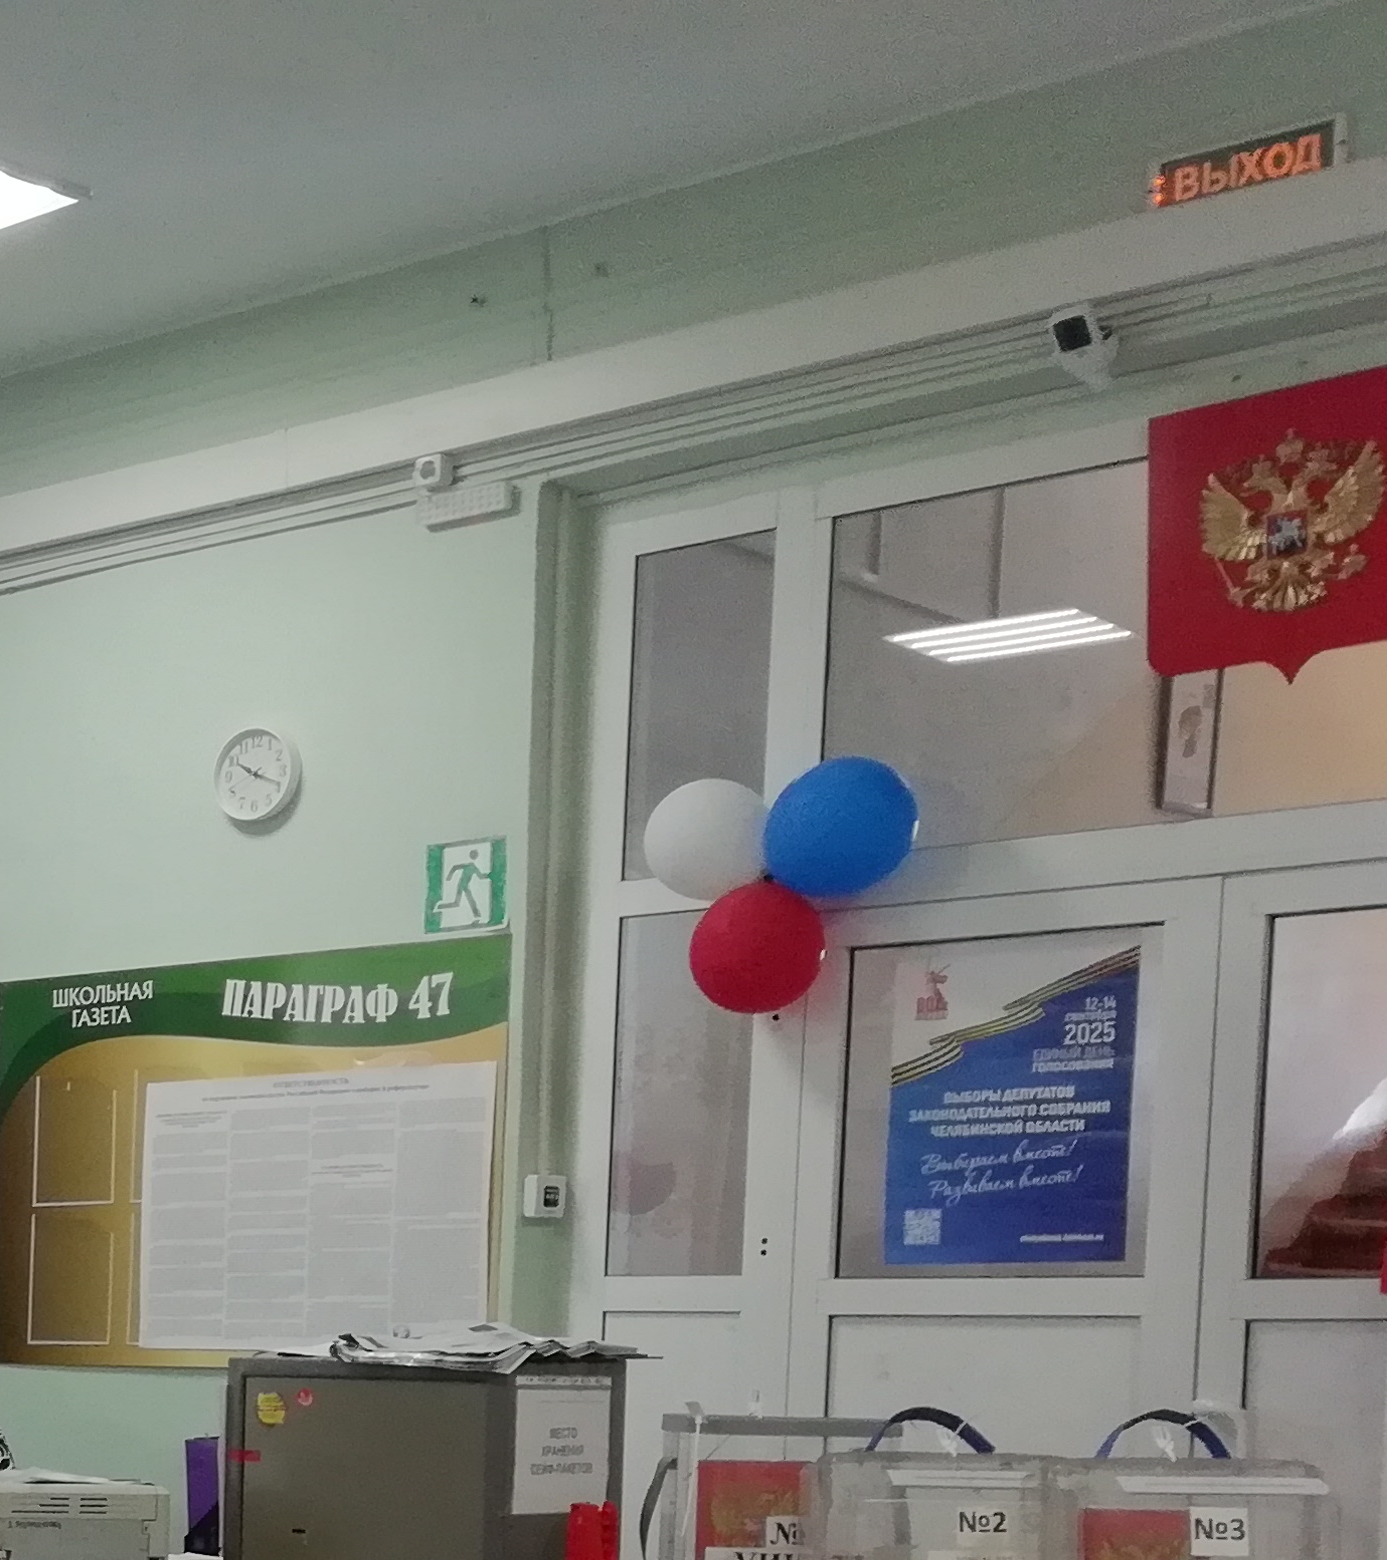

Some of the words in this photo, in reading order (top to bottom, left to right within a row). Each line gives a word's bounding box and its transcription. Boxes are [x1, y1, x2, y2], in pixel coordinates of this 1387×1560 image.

[1175, 133, 1322, 202] ВЫХОД
[52, 980, 154, 1008] ШКОЛЬНАЯ
[221, 978, 399, 1023] ПАРАГРАФ
[408, 972, 454, 1019] 47
[1085, 995, 1118, 1011] 12-14
[71, 1005, 132, 1028] ГАЗЕТА
[1063, 1021, 1116, 1045] 2025
[943, 1088, 1001, 1104] ВЫБОРЫ
[1002, 1085, 1076, 1102] ДЕПУТАТОВ
[1026, 1119, 1086, 1133] ОБЛАСТИ
[958, 1510, 1007, 1533] №2
[1194, 1518, 1245, 1541] №3
